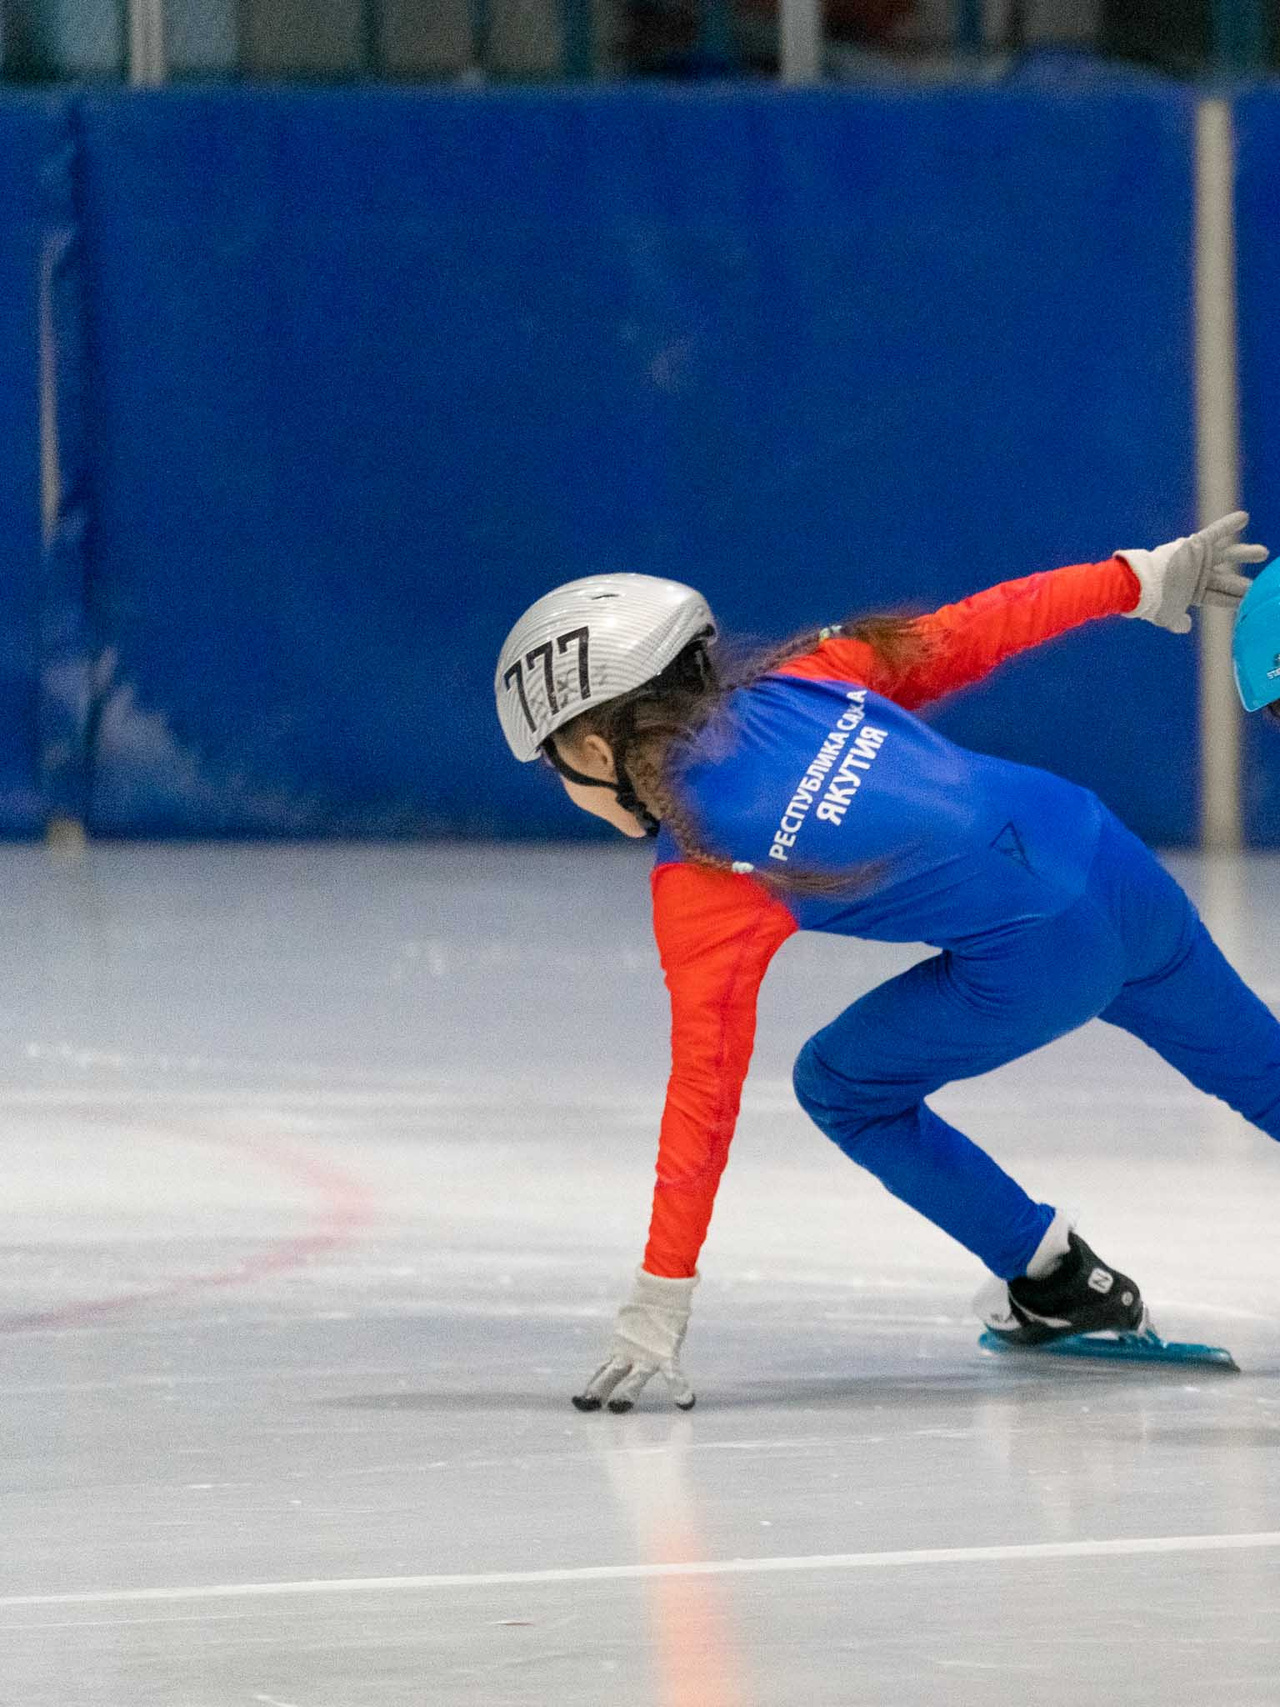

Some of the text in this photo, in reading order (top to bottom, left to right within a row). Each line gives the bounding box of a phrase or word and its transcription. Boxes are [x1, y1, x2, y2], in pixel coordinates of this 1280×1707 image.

[503, 625, 591, 734] 777
[768, 732, 850, 861] РЕСПУБЛИКА
[816, 726, 888, 826] ЯКУТИЯ
